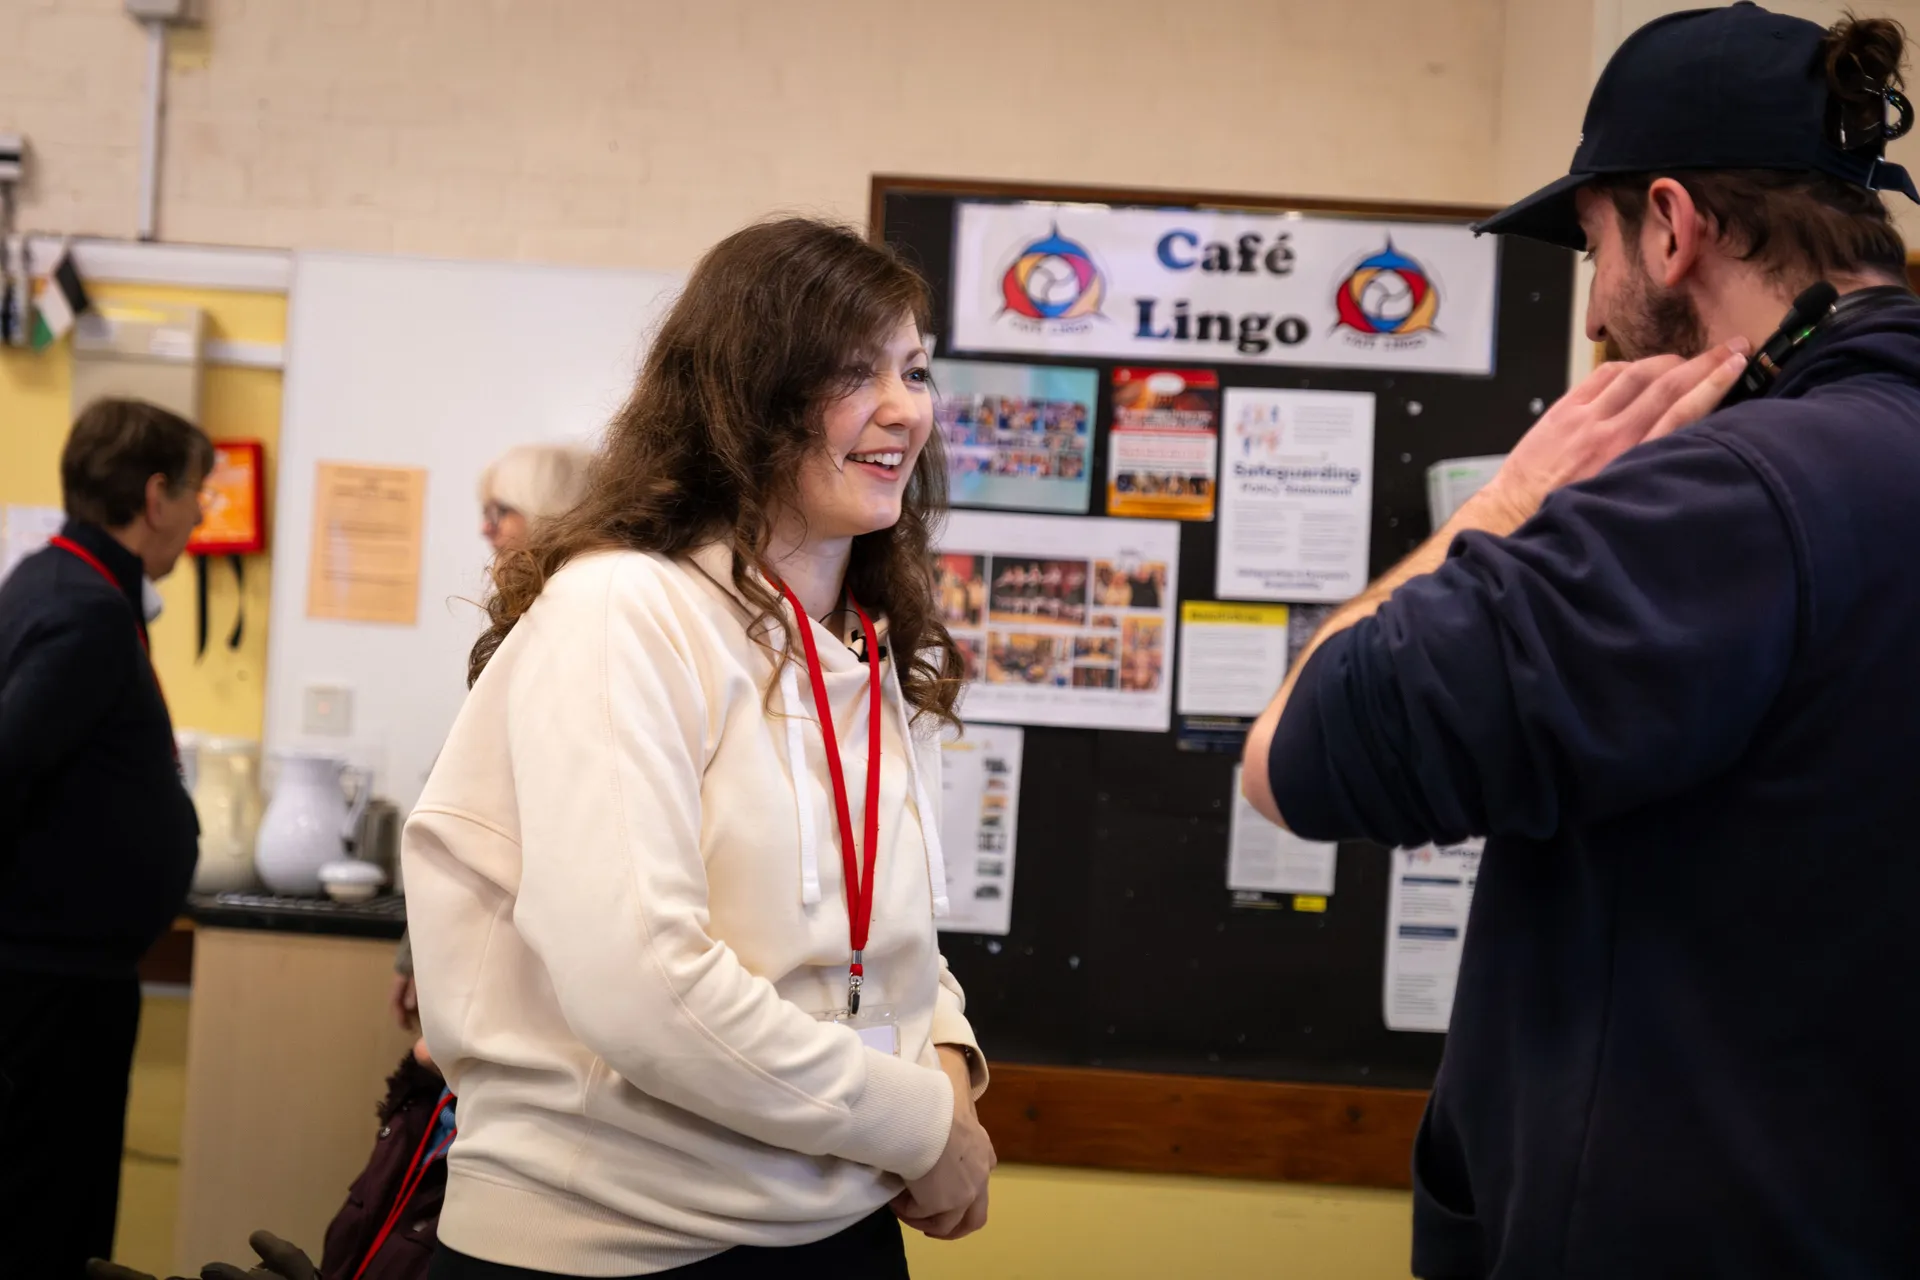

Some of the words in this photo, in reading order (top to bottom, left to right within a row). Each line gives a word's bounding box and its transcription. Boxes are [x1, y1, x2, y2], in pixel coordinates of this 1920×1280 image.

[1157, 230, 1294, 275] Café
[1135, 299, 1310, 354] Lingo
[1234, 461, 1361, 485] Safeguarding
